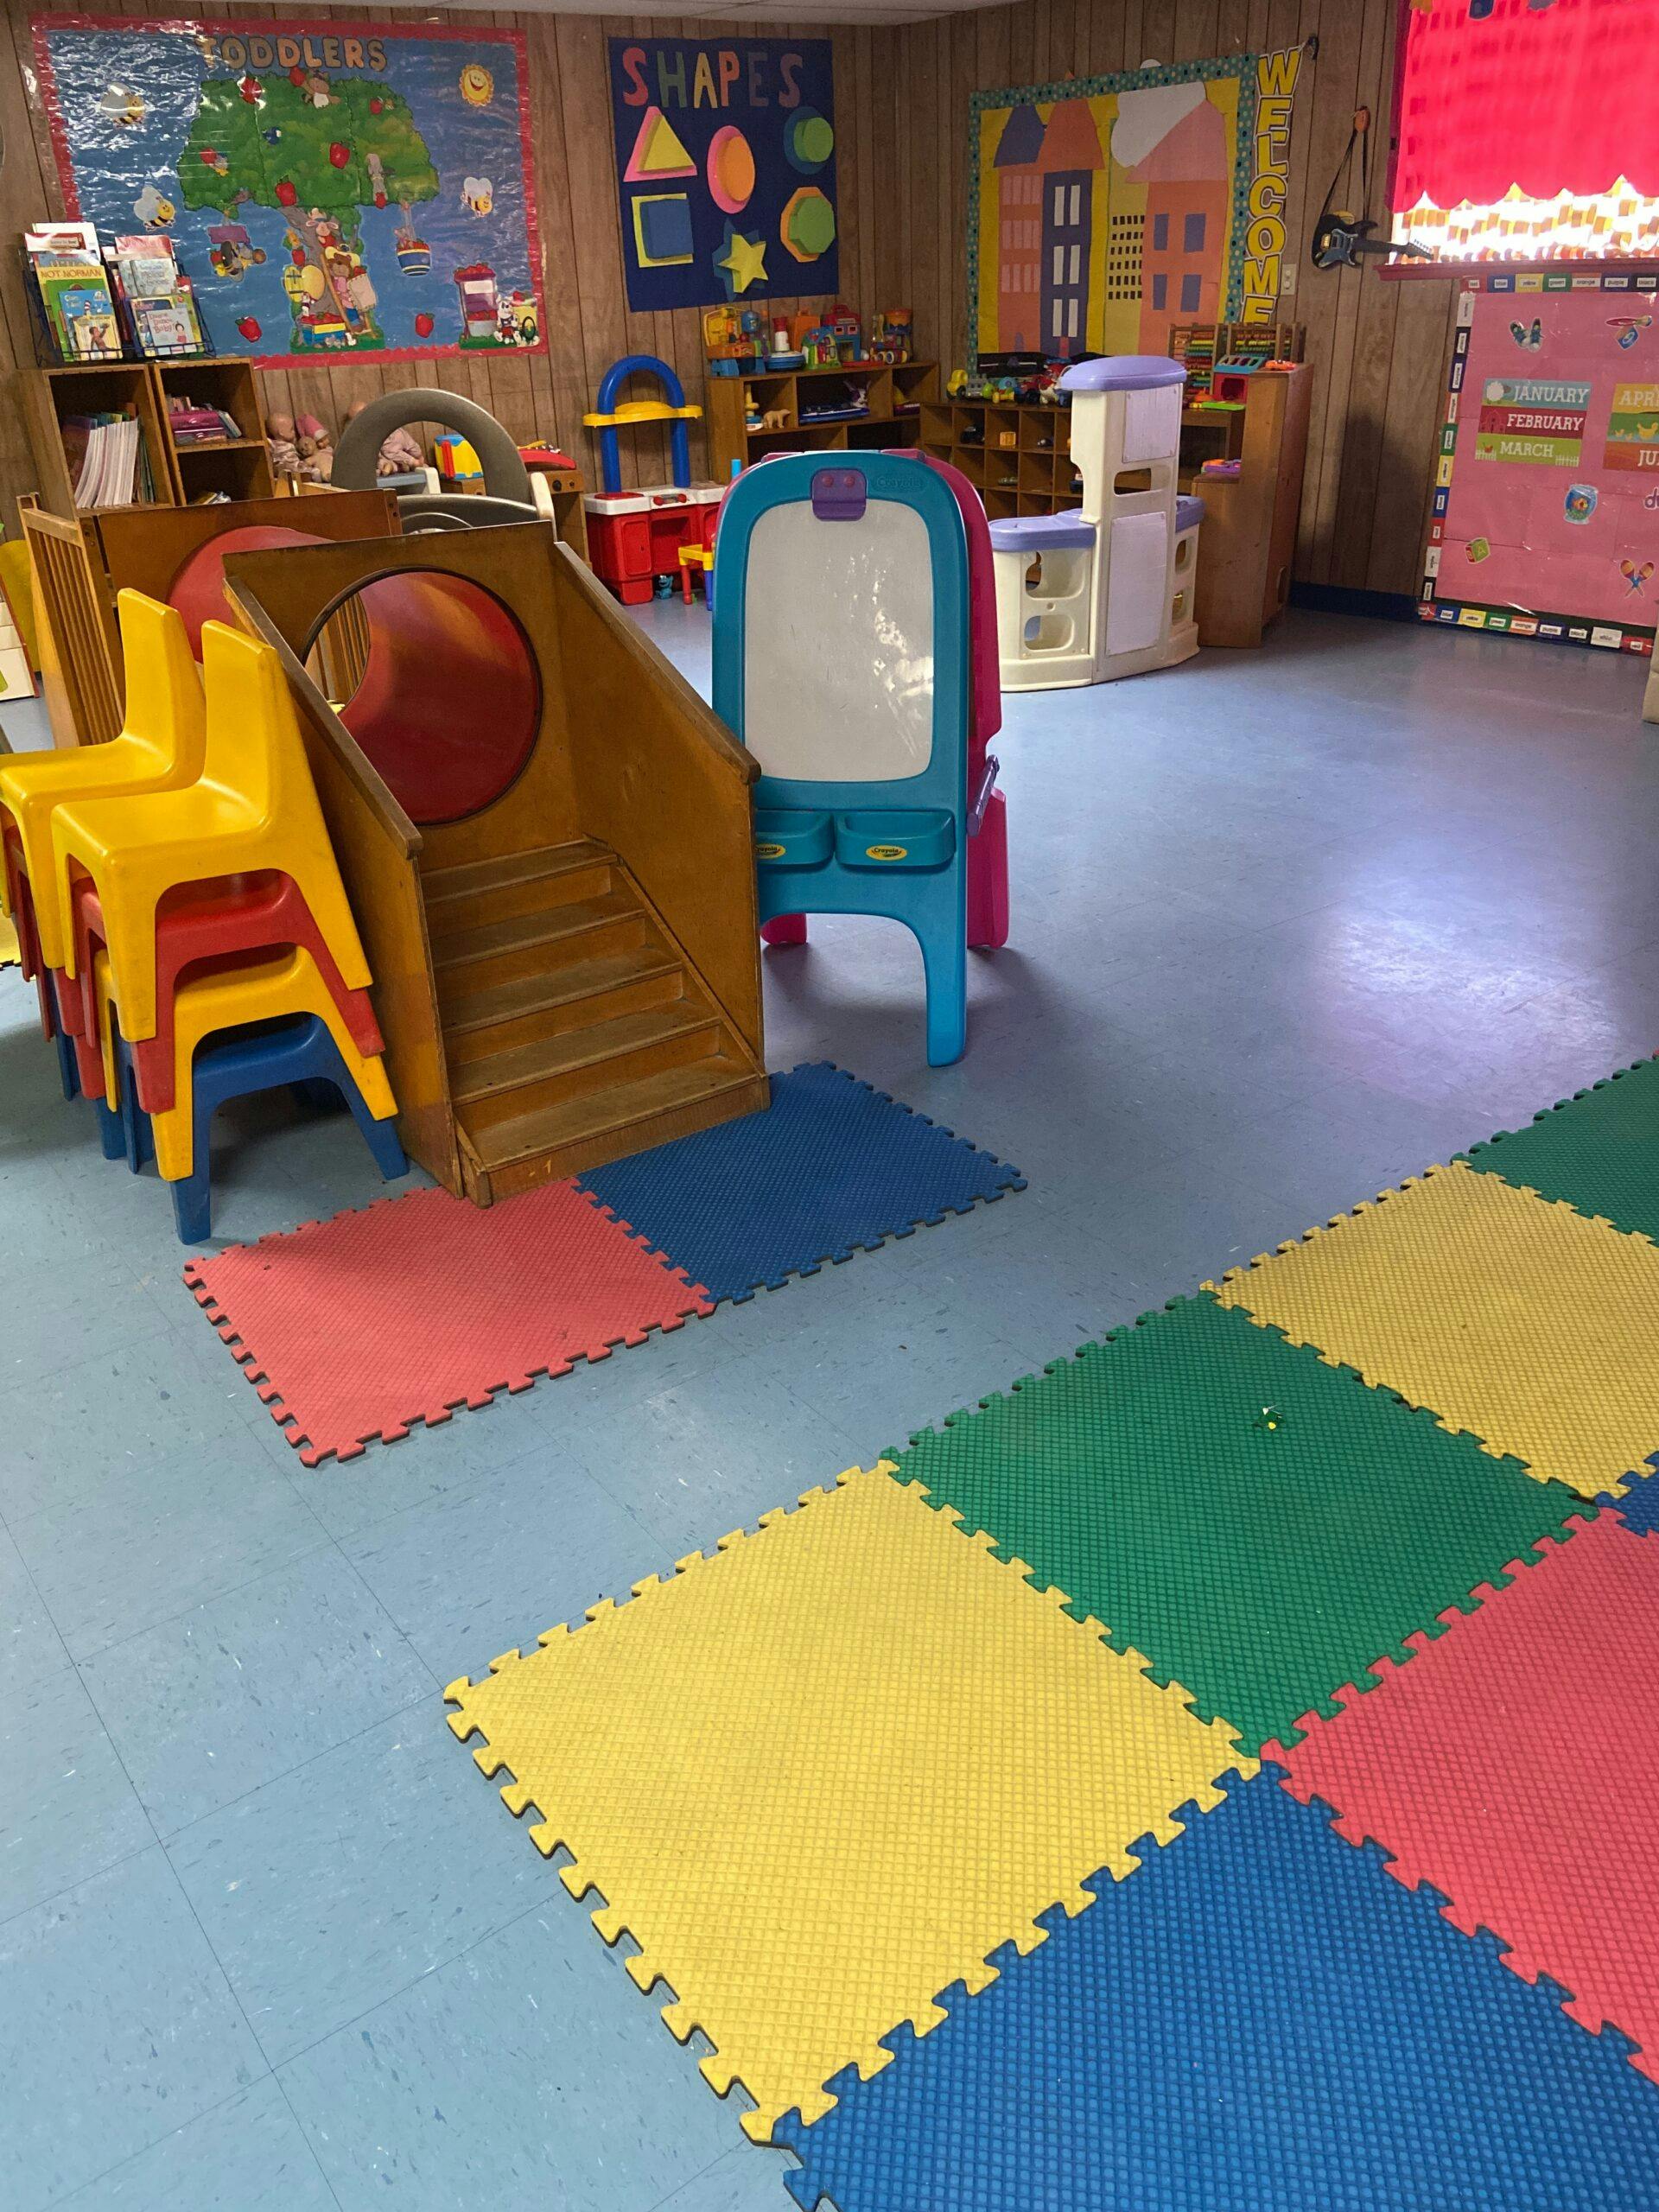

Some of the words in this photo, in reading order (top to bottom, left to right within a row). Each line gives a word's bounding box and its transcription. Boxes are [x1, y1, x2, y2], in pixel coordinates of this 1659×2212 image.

[194, 35, 388, 73] TODDLERS
[622, 47, 803, 108] SHAPES
[1242, 45, 1302, 326] WELCOME
[41, 270, 60, 278] NOT
[63, 269, 102, 278] NORMAN
[1513, 385, 1589, 404] JANUARY
[1618, 390, 1659, 408] APR
[1507, 413, 1584, 431] FEBRUARY
[1499, 442, 1555, 458] MARCH
[1637, 449, 1659, 467] JU
